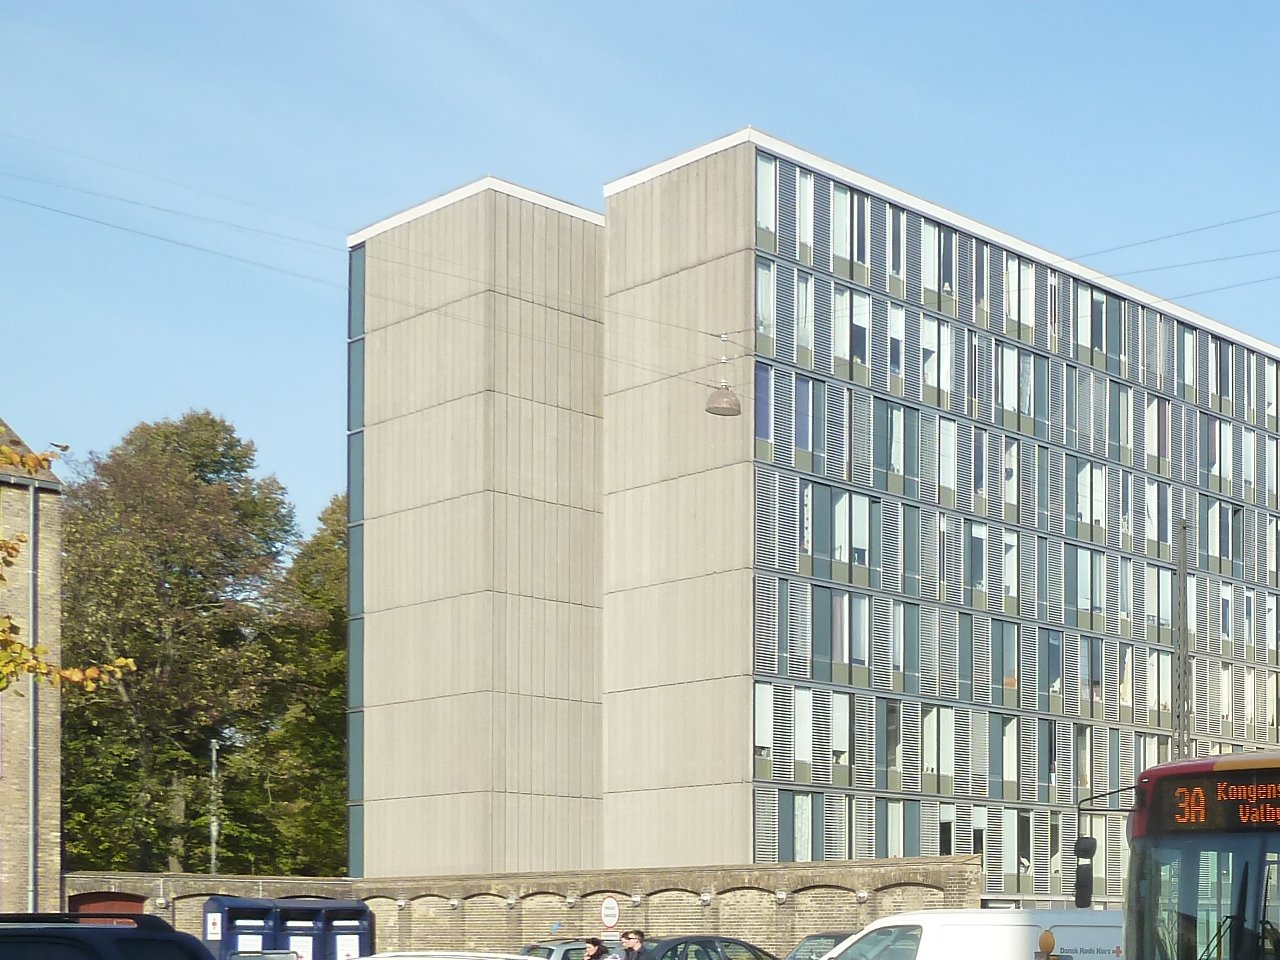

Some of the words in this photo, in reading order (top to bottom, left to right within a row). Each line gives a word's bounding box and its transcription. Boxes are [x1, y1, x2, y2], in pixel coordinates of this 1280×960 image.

[1174, 787, 1207, 823] 3A
[1059, 947, 1079, 955] Dansk
[1097, 947, 1112, 955] Kors
